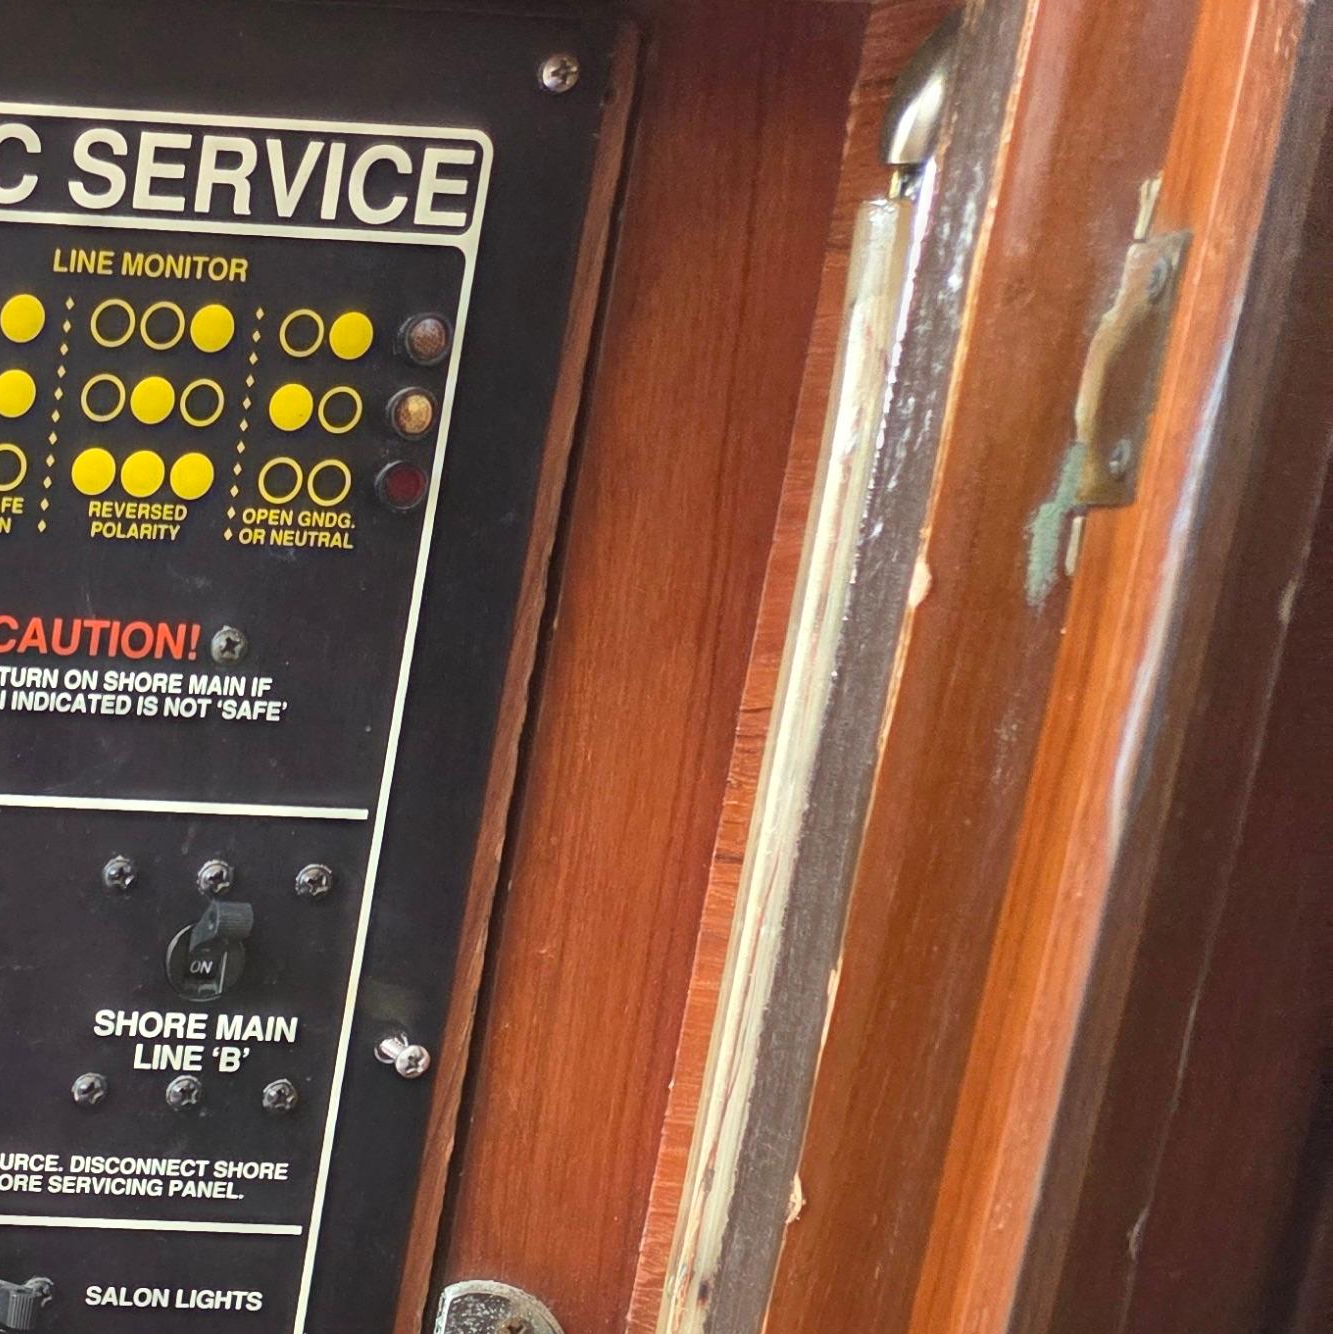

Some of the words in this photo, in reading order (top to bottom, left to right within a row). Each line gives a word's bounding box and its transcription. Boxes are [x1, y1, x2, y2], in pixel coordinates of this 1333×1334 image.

[68, 128, 475, 227] SERVICE
[54, 249, 114, 274] LINE
[122, 252, 248, 282] MONITOR
[89, 501, 187, 520] REVERSED
[243, 508, 293, 525] OPEN
[298, 511, 355, 528] GNDG.
[91, 521, 180, 540] POLARITY
[239, 528, 265, 544] OR
[270, 529, 353, 548] NEUTRAL
[64, 669, 98, 690] ON
[104, 671, 183, 693] SHORE
[189, 674, 246, 696] MAIN
[251, 677, 272, 697] IF
[12, 691, 131, 714] INDICATED
[137, 696, 158, 716] IS
[164, 697, 212, 717] NOT
[70, 1156, 210, 1176] DISCONNECT
[213, 1161, 288, 1180] SHORE
[48, 1175, 163, 1196] SERVICING
[169, 1180, 244, 1199] PANEL.
[85, 1286, 170, 1307] SALON
[176, 1289, 262, 1310] LIGHTS
